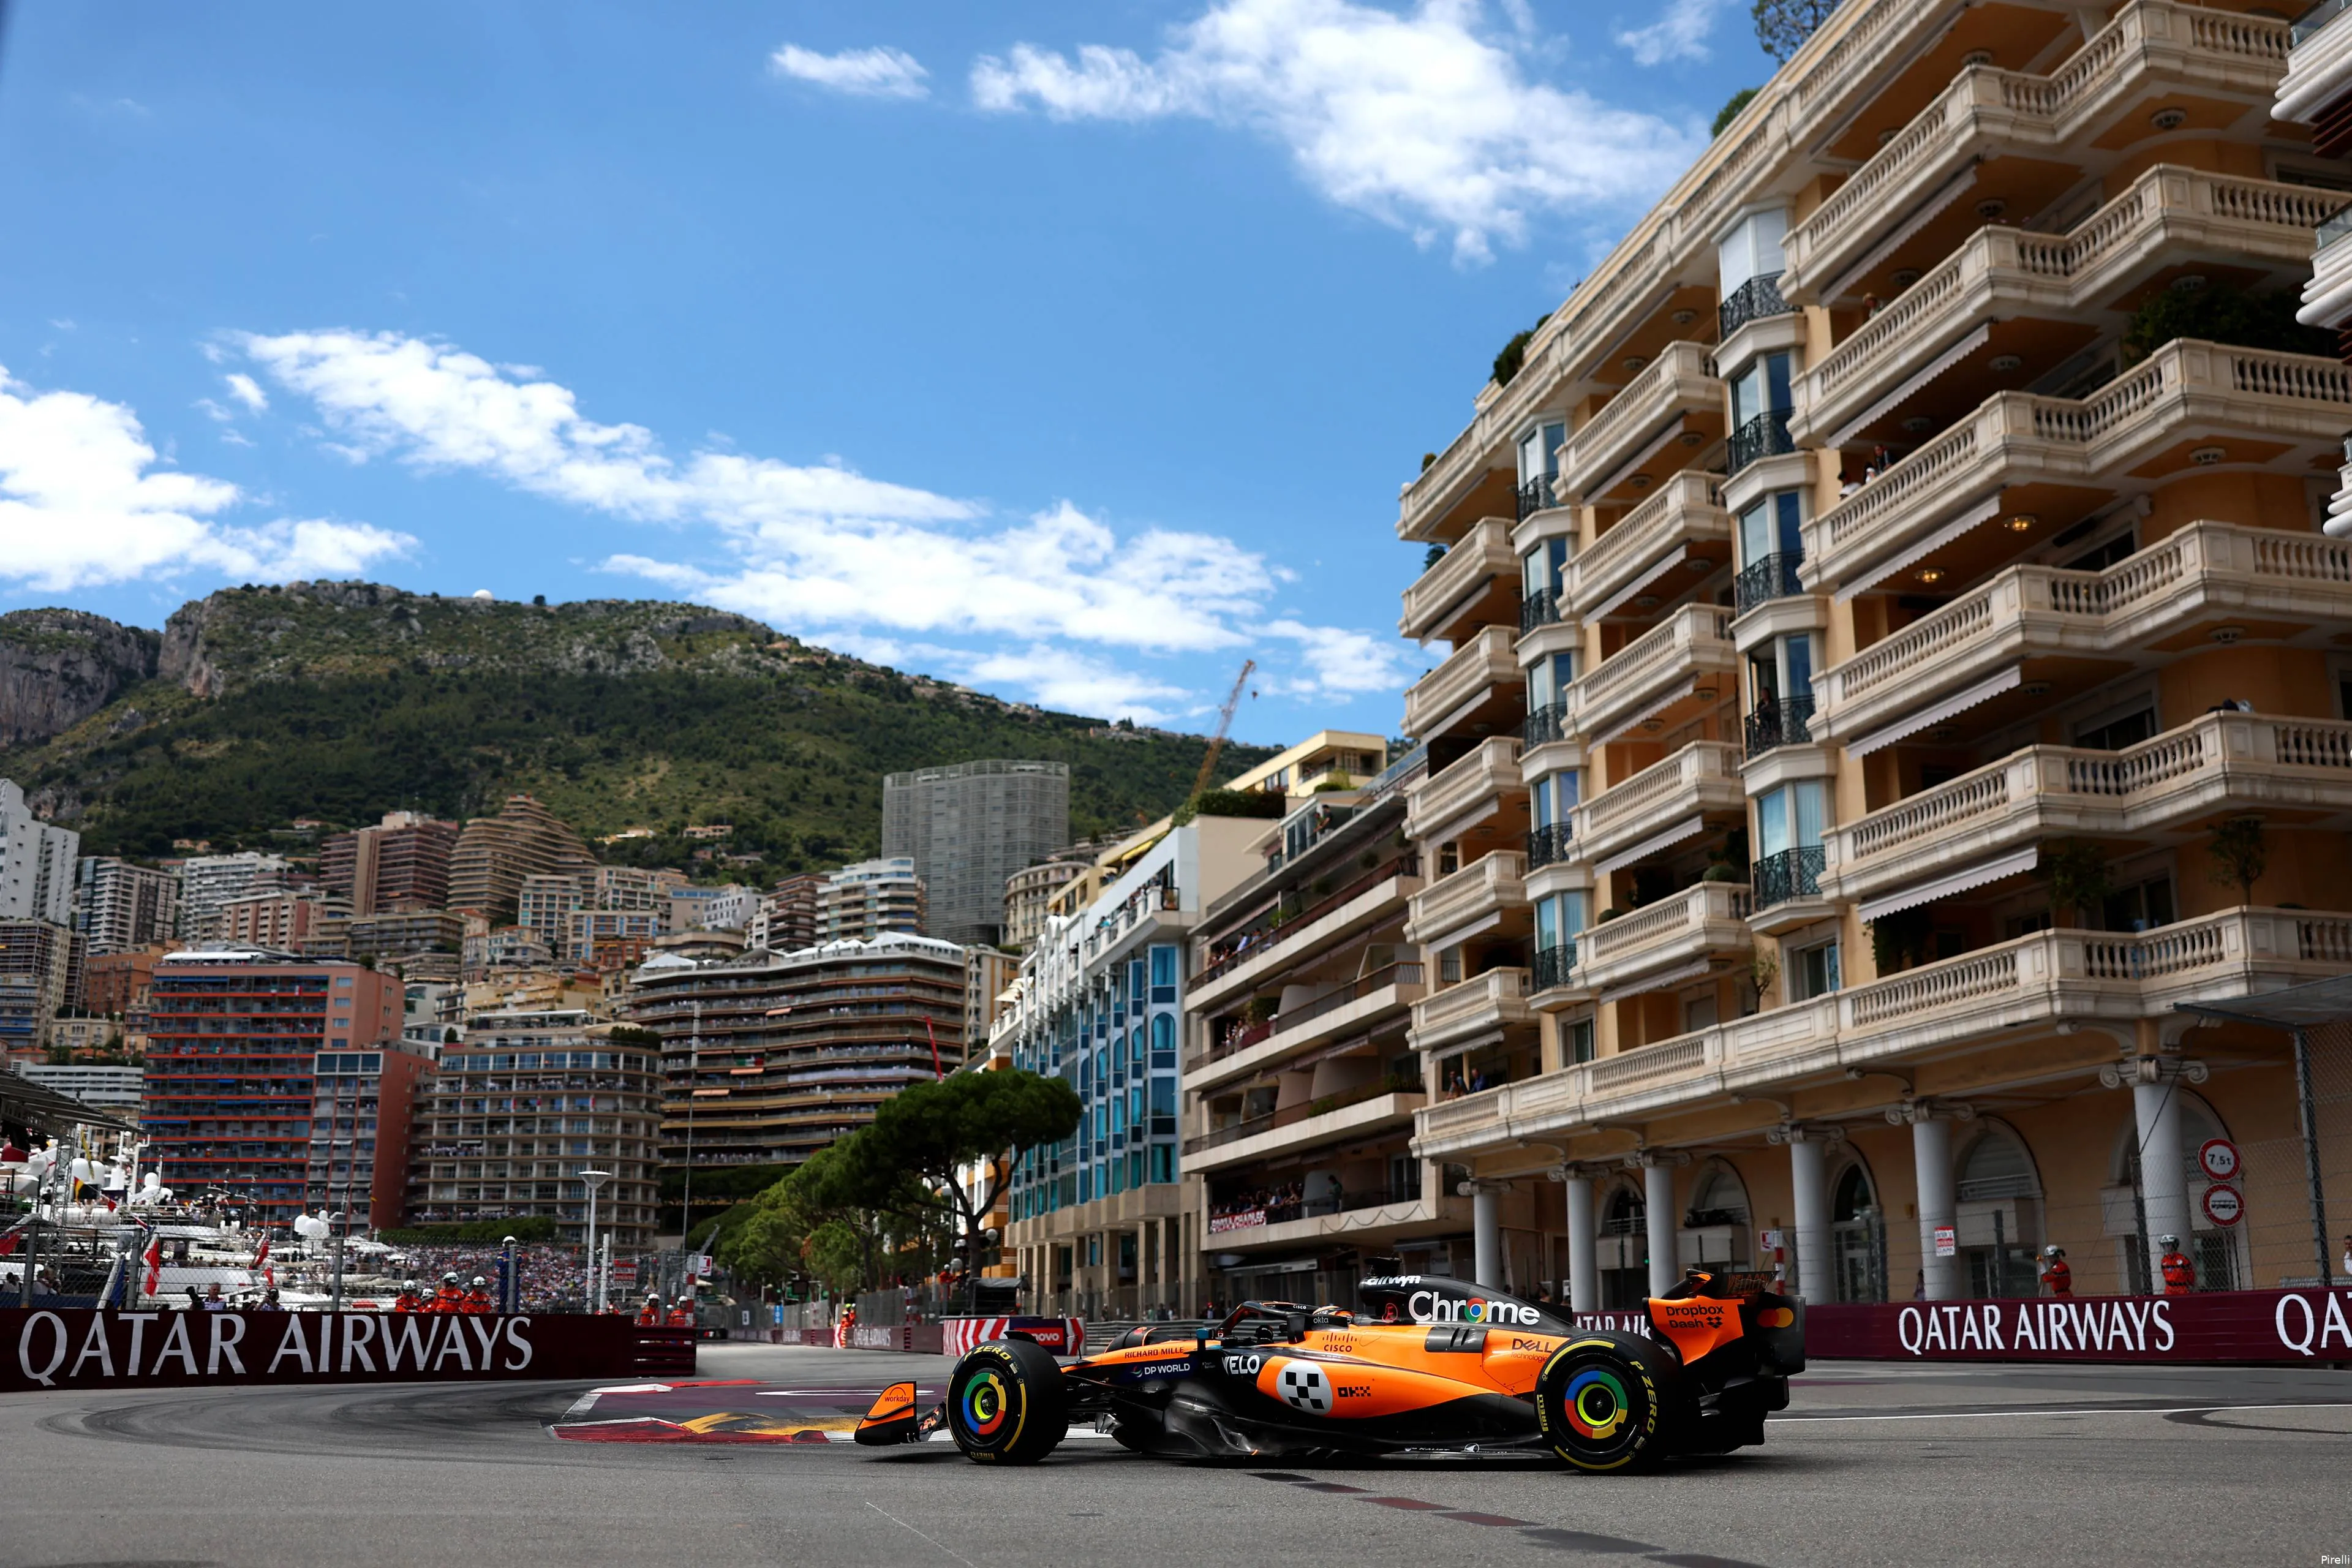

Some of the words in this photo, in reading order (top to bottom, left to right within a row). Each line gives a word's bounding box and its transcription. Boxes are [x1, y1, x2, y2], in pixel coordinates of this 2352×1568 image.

[1366, 1275, 1422, 1287] allwyn
[1409, 1291, 1540, 1325] Chrome
[1665, 1305, 1725, 1317] Dropbox
[1575, 1315, 1616, 1332] ATAR
[1623, 1314, 1653, 1340] AIR
[1669, 1318, 1704, 1329] Dash
[1898, 1305, 2006, 1355] QATAR
[2013, 1299, 2175, 1351] AIRWAYS
[2275, 1291, 2352, 1357] QA
[1031, 1333, 1060, 1341] novo
[18, 1311, 247, 1387] QATAR
[266, 1313, 533, 1374] AIRWAYS
[973, 1345, 1012, 1361] ZERO
[1124, 1349, 1158, 1359] RICHARD
[1161, 1346, 1184, 1356] MILLE
[1512, 1338, 1553, 1354] DELL
[1222, 1354, 1260, 1375] VELO
[1510, 1352, 1548, 1363] Technologie
[1144, 1366, 1157, 1375] DP
[1158, 1362, 1190, 1374] WORLD
[884, 1393, 910, 1404] workday
[1337, 1385, 1371, 1398] OKX
[1629, 1360, 1645, 1371] P
[1641, 1375, 1658, 1434] ZERO
[1536, 1393, 1549, 1432] PIRELLI
